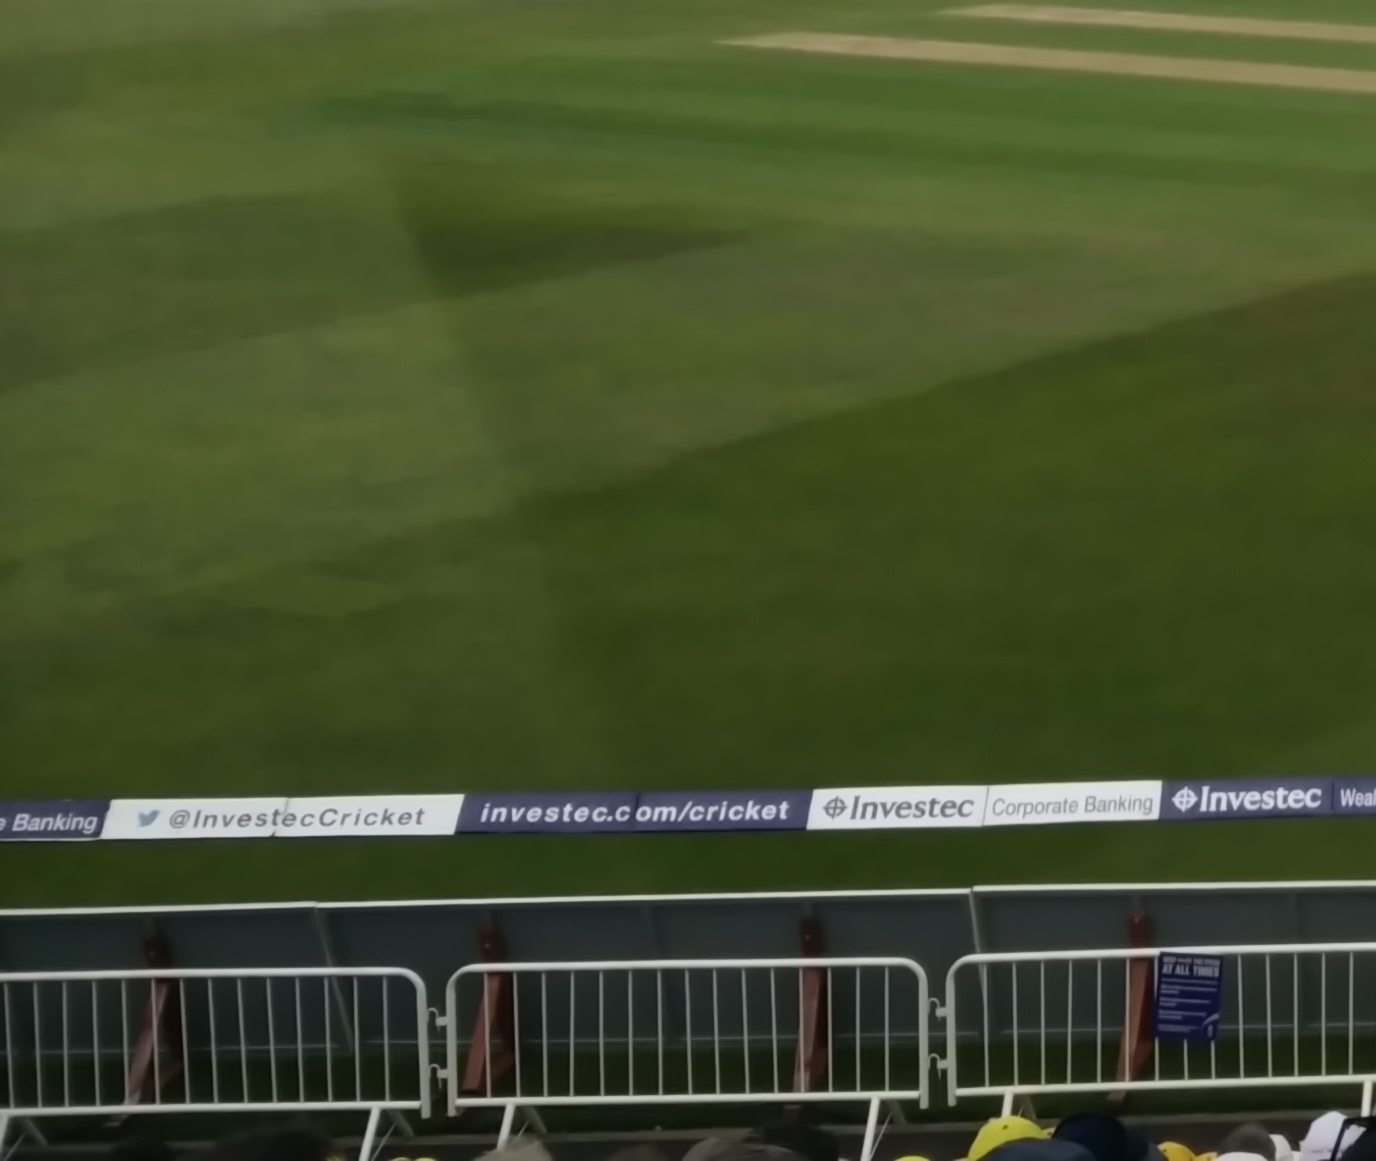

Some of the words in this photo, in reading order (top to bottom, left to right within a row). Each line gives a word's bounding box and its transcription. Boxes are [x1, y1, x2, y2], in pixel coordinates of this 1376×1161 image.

[850, 795, 974, 820] Investec
[992, 798, 1078, 818] Corporate
[1084, 796, 1153, 815] Banking
[1200, 786, 1322, 812] Investec
[12, 812, 98, 833] Banking
[168, 807, 425, 830] @InvestecCricket
[480, 800, 790, 823] investec.com/cricket
